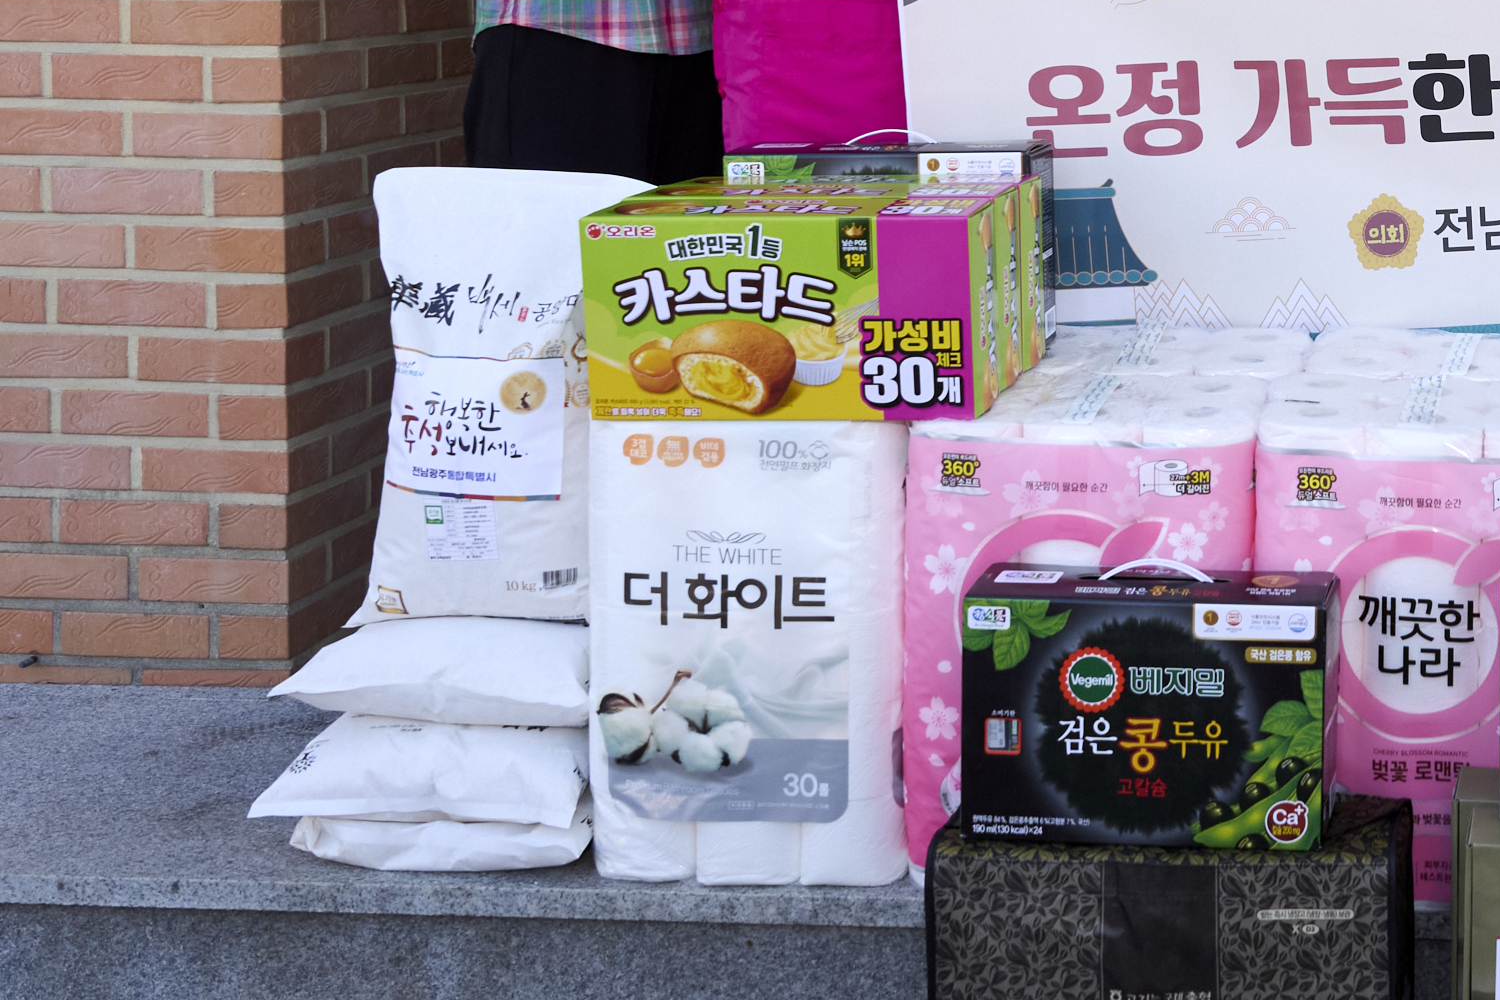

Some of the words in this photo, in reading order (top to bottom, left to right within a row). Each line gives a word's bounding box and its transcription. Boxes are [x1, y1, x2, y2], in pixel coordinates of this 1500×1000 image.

[1026, 60, 1204, 159] 온정
[605, 225, 655, 237] 오리온
[1367, 224, 1406, 247] 의회
[667, 236, 743, 260] 대한민국
[746, 223, 781, 259] 1등
[845, 253, 865, 267] 1위
[613, 265, 837, 326] 카스타드
[863, 319, 962, 352] 가성비
[936, 352, 962, 368] 체크
[862, 356, 962, 404] 30개
[425, 391, 501, 431] 행복한
[401, 405, 443, 456] 추석
[700, 442, 719, 451] 비데
[758, 439, 808, 459] 100%
[412, 466, 496, 482] 전남광주통합특별시
[759, 460, 799, 471] 천연펄프
[801, 460, 832, 472] 화장지
[957, 477, 981, 487] 소프트
[1024, 481, 1060, 493] 깨끗함이
[1062, 482, 1088, 493] 필요한
[1090, 482, 1108, 493] 순간
[1176, 484, 1185, 494] 더
[1187, 483, 1210, 494] 길어진
[1314, 492, 1337, 501] 소프트
[1378, 496, 1414, 508] 깨끗함이
[1416, 497, 1442, 508] 필요한
[1444, 498, 1462, 509] 순간
[673, 545, 711, 563] THE
[719, 548, 782, 565] WHITE
[623, 571, 668, 626] 더
[683, 573, 835, 629] 화이트
[1358, 594, 1481, 643] 깨끗한
[1250, 649, 1267, 660] 국산
[1269, 650, 1293, 661] 검은콩
[1295, 650, 1312, 661] 함유
[1377, 644, 1461, 687] 나라
[1070, 672, 1114, 687] Vegemil
[1128, 666, 1225, 697] 베지밀
[1372, 759, 1408, 782] 벚꽃
[1117, 778, 1168, 798] 고칼슘
[972, 824, 986, 832] 190
